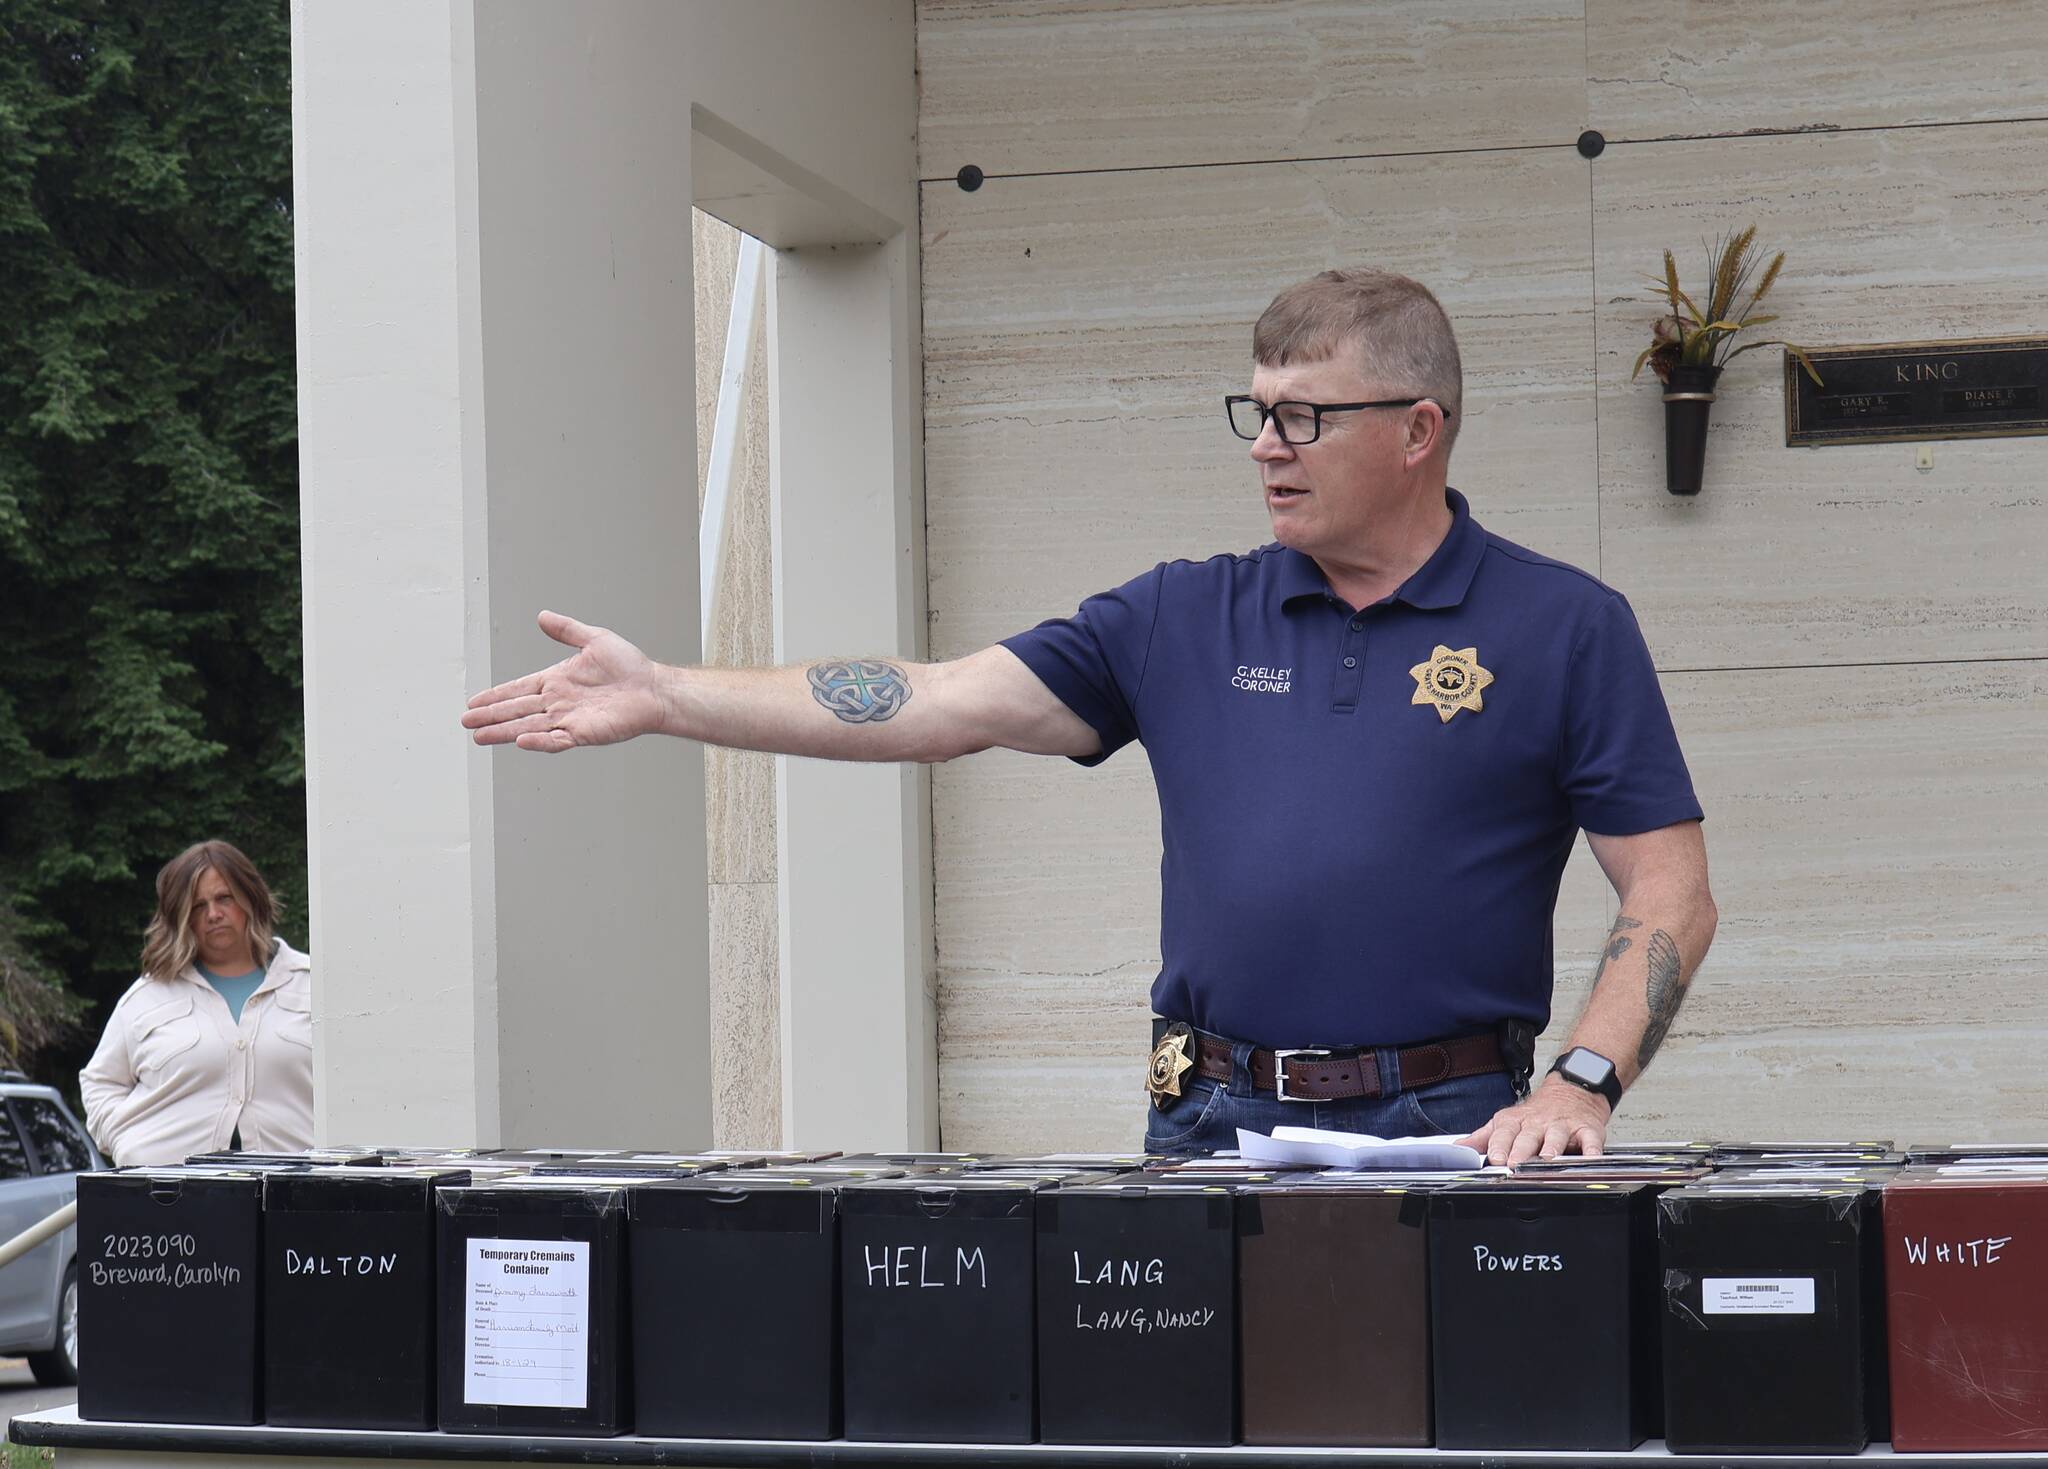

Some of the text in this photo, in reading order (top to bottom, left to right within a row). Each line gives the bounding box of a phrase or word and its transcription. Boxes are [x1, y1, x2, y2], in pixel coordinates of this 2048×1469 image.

[1896, 361, 1959, 382] KING
[1841, 397, 1872, 407] GARY
[1965, 390, 2000, 401] DIANE
[1436, 655, 1468, 666] CORONER
[1237, 665, 1292, 681] G.KELLEY
[1231, 676, 1291, 693] CORONER
[1430, 689, 1460, 701] HARBOR
[1461, 673, 1478, 698] COUNTY
[1440, 703, 1452, 711] WA
[103, 1234, 196, 1258] 2023090
[1904, 1236, 2012, 1267] WHITE
[286, 1249, 398, 1275] DALTON
[480, 1248, 576, 1262] Temporary Cremains
[503, 1264, 550, 1275] Container
[865, 1245, 986, 1288] HELM
[1073, 1250, 1163, 1284] LANG
